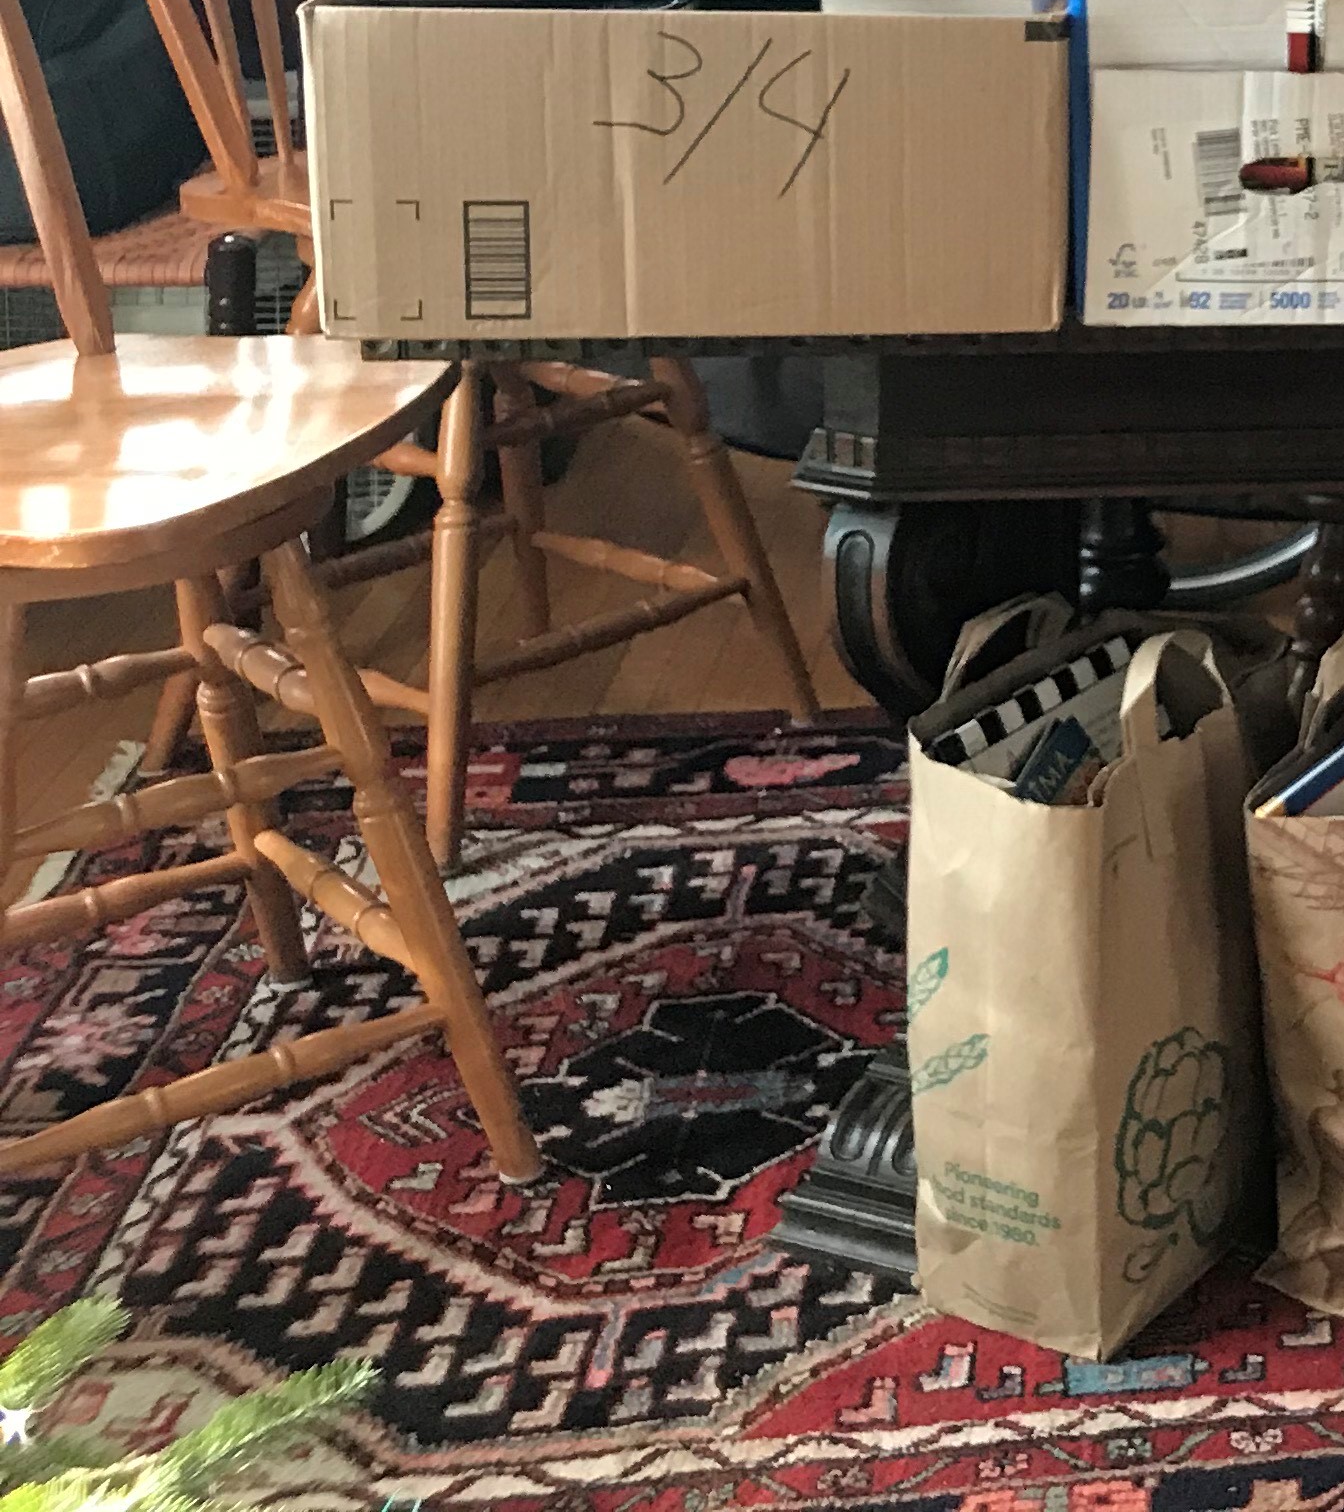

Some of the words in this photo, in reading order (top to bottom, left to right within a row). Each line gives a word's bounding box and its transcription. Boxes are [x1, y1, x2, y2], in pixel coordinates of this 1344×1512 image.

[592, 30, 851, 197] 3/4
[1107, 291, 1130, 309] 20
[1189, 291, 1211, 309] 92
[1270, 291, 1312, 310] 5000
[943, 1161, 1040, 1209] Pioneering
[945, 1206, 988, 1232] since
[969, 1194, 1062, 1230] standards
